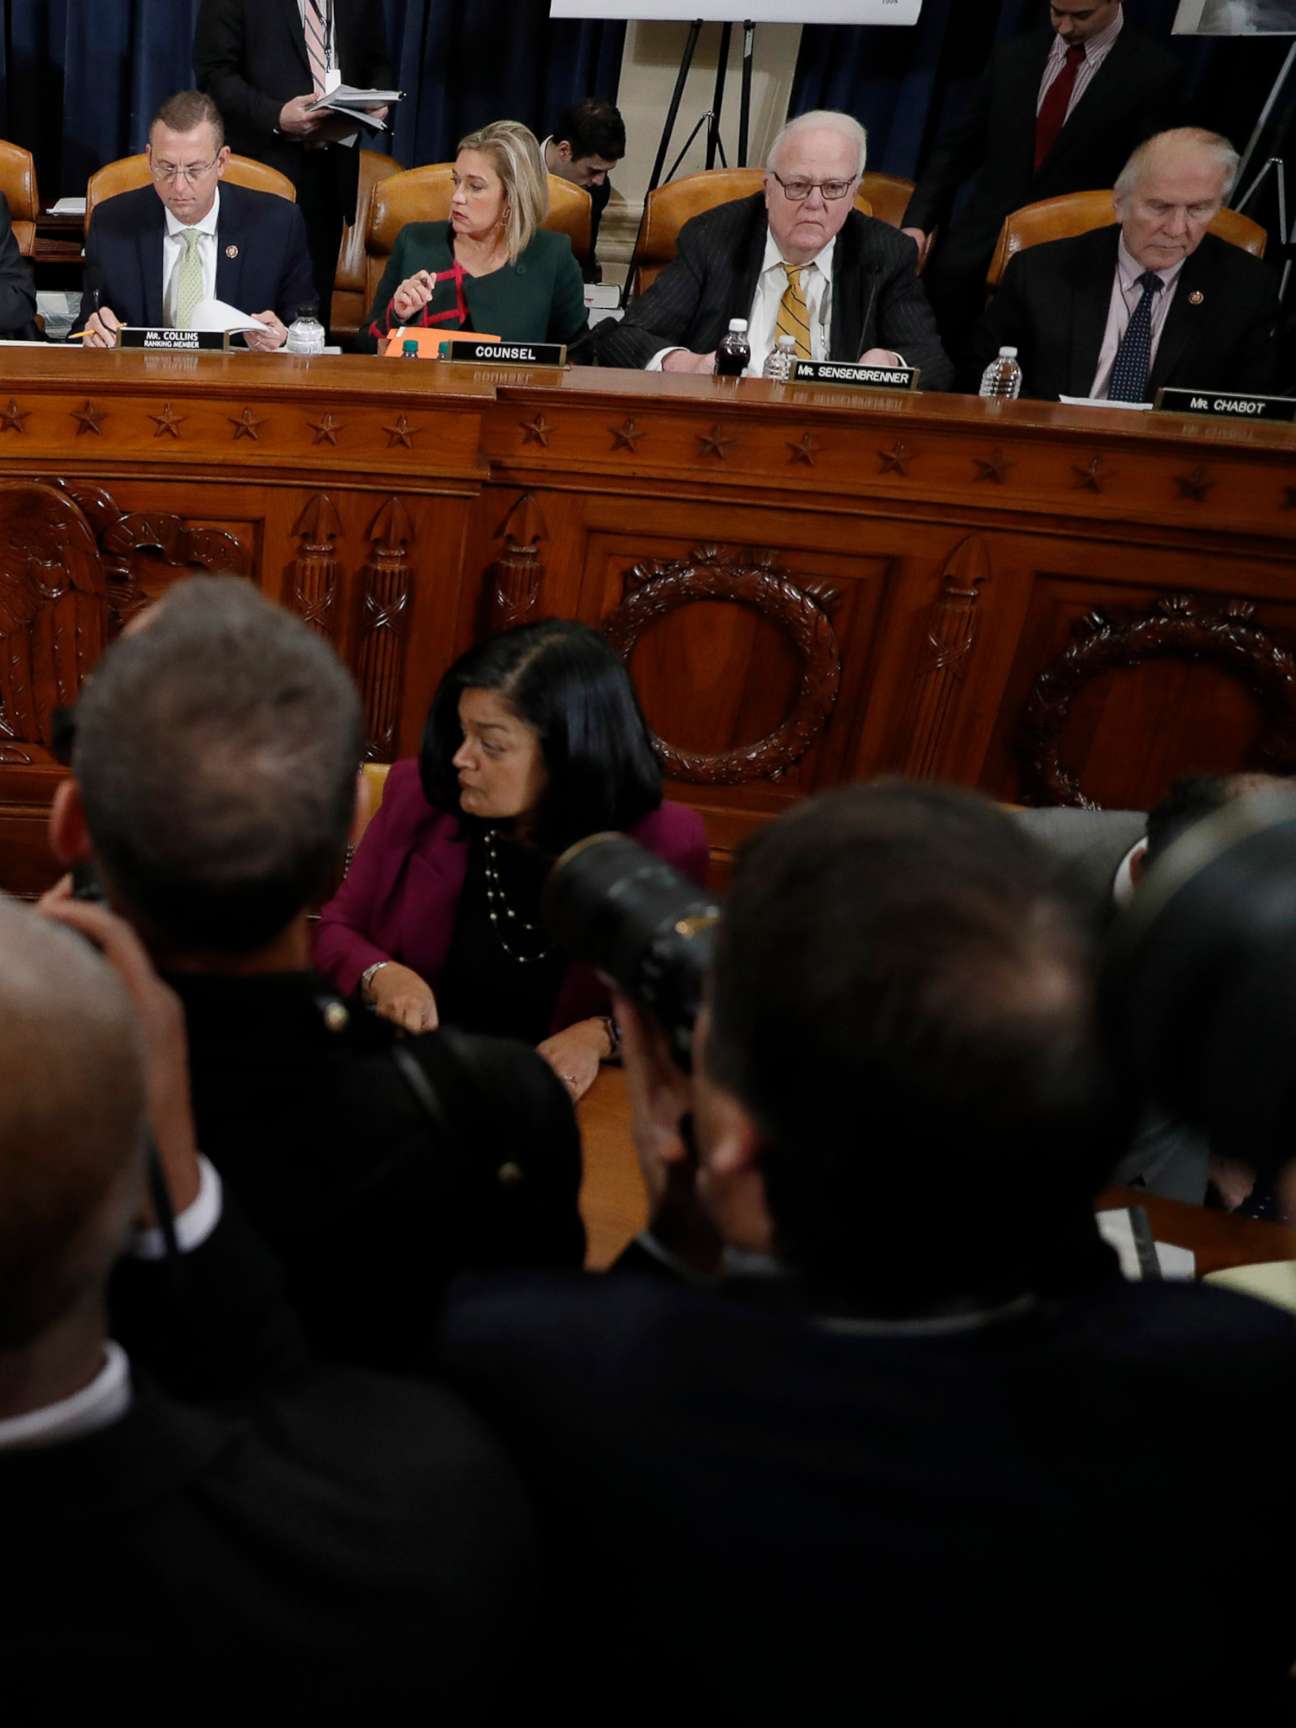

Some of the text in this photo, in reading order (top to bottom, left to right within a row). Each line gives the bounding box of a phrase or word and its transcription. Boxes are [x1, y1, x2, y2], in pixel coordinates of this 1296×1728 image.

[163, 331, 199, 341] COLLINS
[144, 340, 200, 349] RANKING MEMBER
[475, 345, 536, 360] COUNSEL
[817, 366, 909, 384] SENSENBRENNER
[1213, 398, 1266, 414] CHABOT
